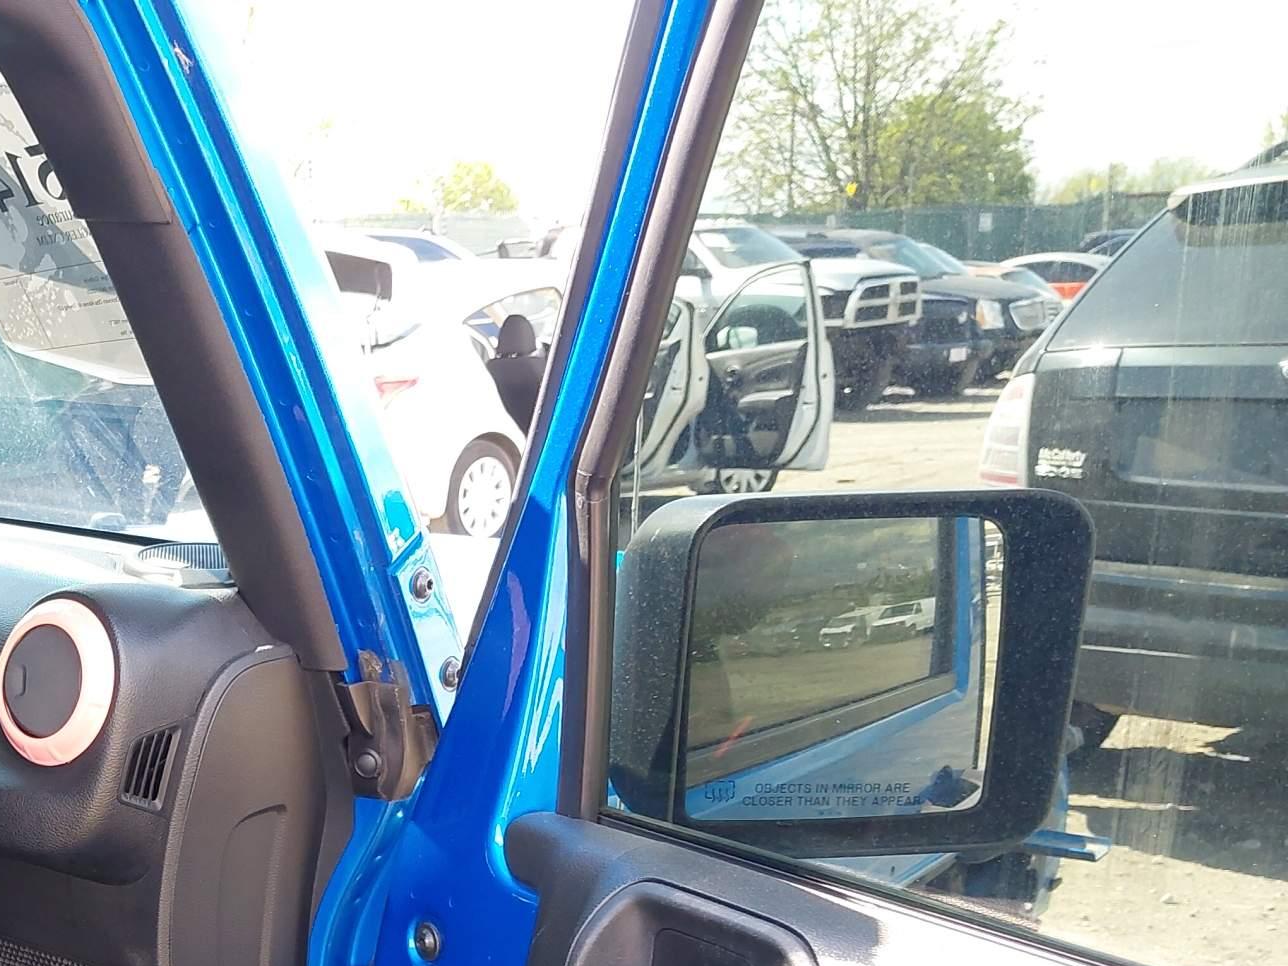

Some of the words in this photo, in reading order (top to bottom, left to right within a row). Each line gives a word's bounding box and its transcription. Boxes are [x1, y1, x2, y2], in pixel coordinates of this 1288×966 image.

[754, 782, 812, 794] OBJECTS
[815, 782, 829, 794] IN
[831, 782, 883, 794] MIRROR
[885, 782, 912, 794] ARE
[741, 795, 793, 807] CLOSER
[798, 795, 831, 807] THAN
[834, 795, 868, 807] THEY
[870, 794, 922, 806] APPEAR
